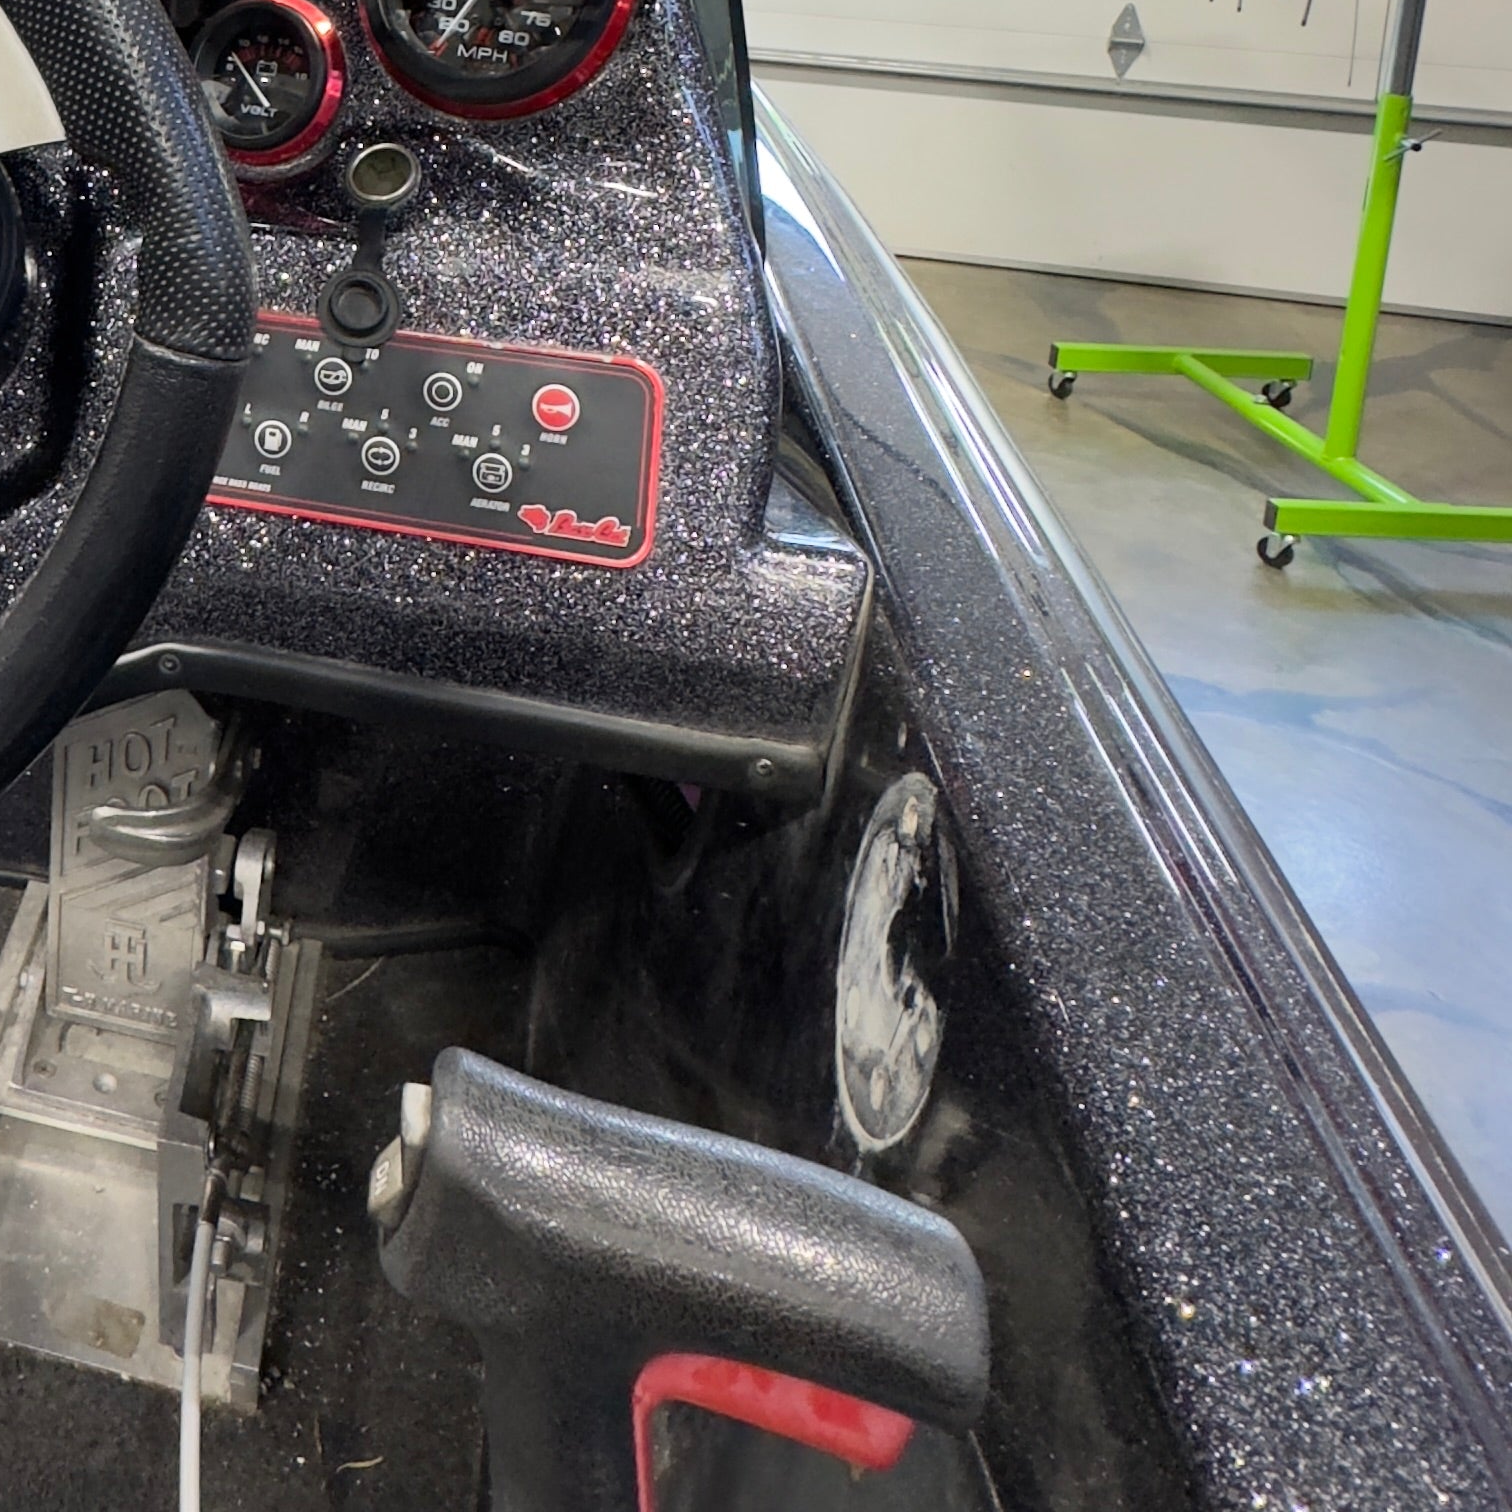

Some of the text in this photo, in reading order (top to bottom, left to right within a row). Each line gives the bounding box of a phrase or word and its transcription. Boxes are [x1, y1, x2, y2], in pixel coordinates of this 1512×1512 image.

[498, 30, 530, 47] 80
[457, 43, 508, 63] MPH
[240, 104, 278, 118] VOLT
[295, 338, 320, 352] MAN
[466, 361, 484, 375] ON
[342, 417, 368, 432] MAN
[429, 416, 451, 428] ACC
[408, 427, 418, 439] 3
[451, 433, 479, 449] MAN
[521, 444, 531, 456] 3
[259, 463, 281, 476] FUEL
[89, 715, 177, 788] HOT
